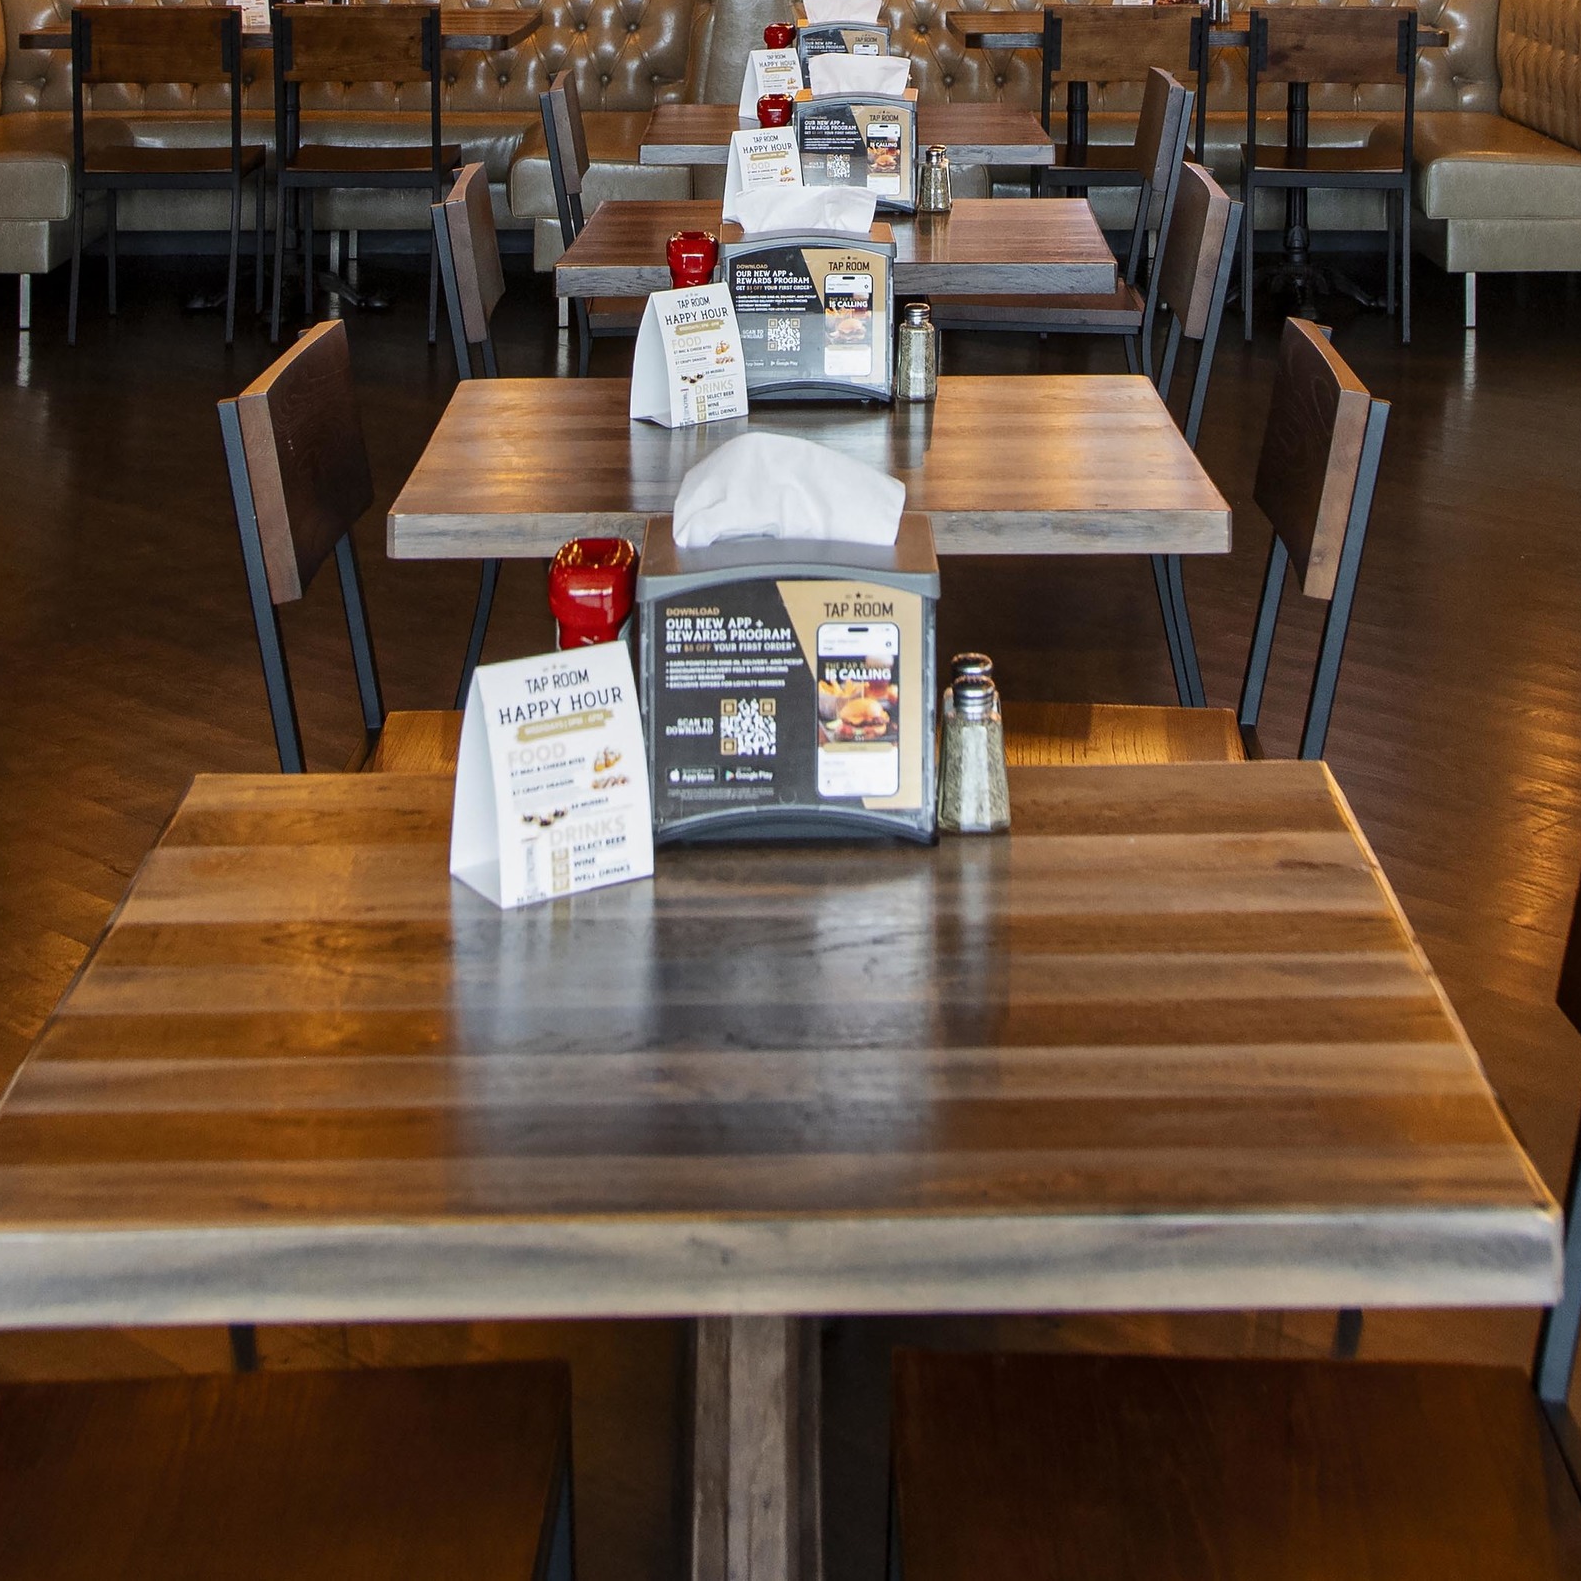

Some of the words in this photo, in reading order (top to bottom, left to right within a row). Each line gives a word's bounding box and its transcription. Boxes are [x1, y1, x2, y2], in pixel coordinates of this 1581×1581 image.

[743, 145, 768, 154] HAPPY
[771, 143, 793, 151] HOUR
[828, 262, 844, 271] TAP
[846, 262, 869, 271] ROOM
[677, 299, 690, 309] TAP
[691, 296, 710, 307] ROOM
[665, 311, 698, 325] HAPPY
[701, 307, 728, 320] HOUR
[671, 337, 702, 349] FOOD
[695, 379, 734, 395] DRINKS
[666, 607, 720, 616] DOWNLOAD
[823, 602, 849, 617] TAP
[853, 602, 894, 617] ROOM
[666, 618, 692, 630] OUR
[696, 618, 724, 629] NEW
[728, 617, 753, 629] APP
[666, 630, 727, 642] REWARDS
[730, 628, 791, 641] PROGRAM
[665, 644, 681, 653] GET
[714, 643, 737, 652] YOUR
[739, 643, 762, 652] FIRST
[825, 670, 837, 681] IS
[838, 669, 892, 681] CALLING
[525, 676, 549, 694] TAP
[552, 669, 589, 688] ROOM
[499, 698, 561, 725] HAPPY
[570, 686, 623, 710] HOUR
[677, 718, 700, 726] SCAN
[703, 717, 713, 726] TO
[666, 726, 713, 735] DOWNLOAD
[508, 742, 566, 767] FOOD
[735, 772, 758, 782] Google
